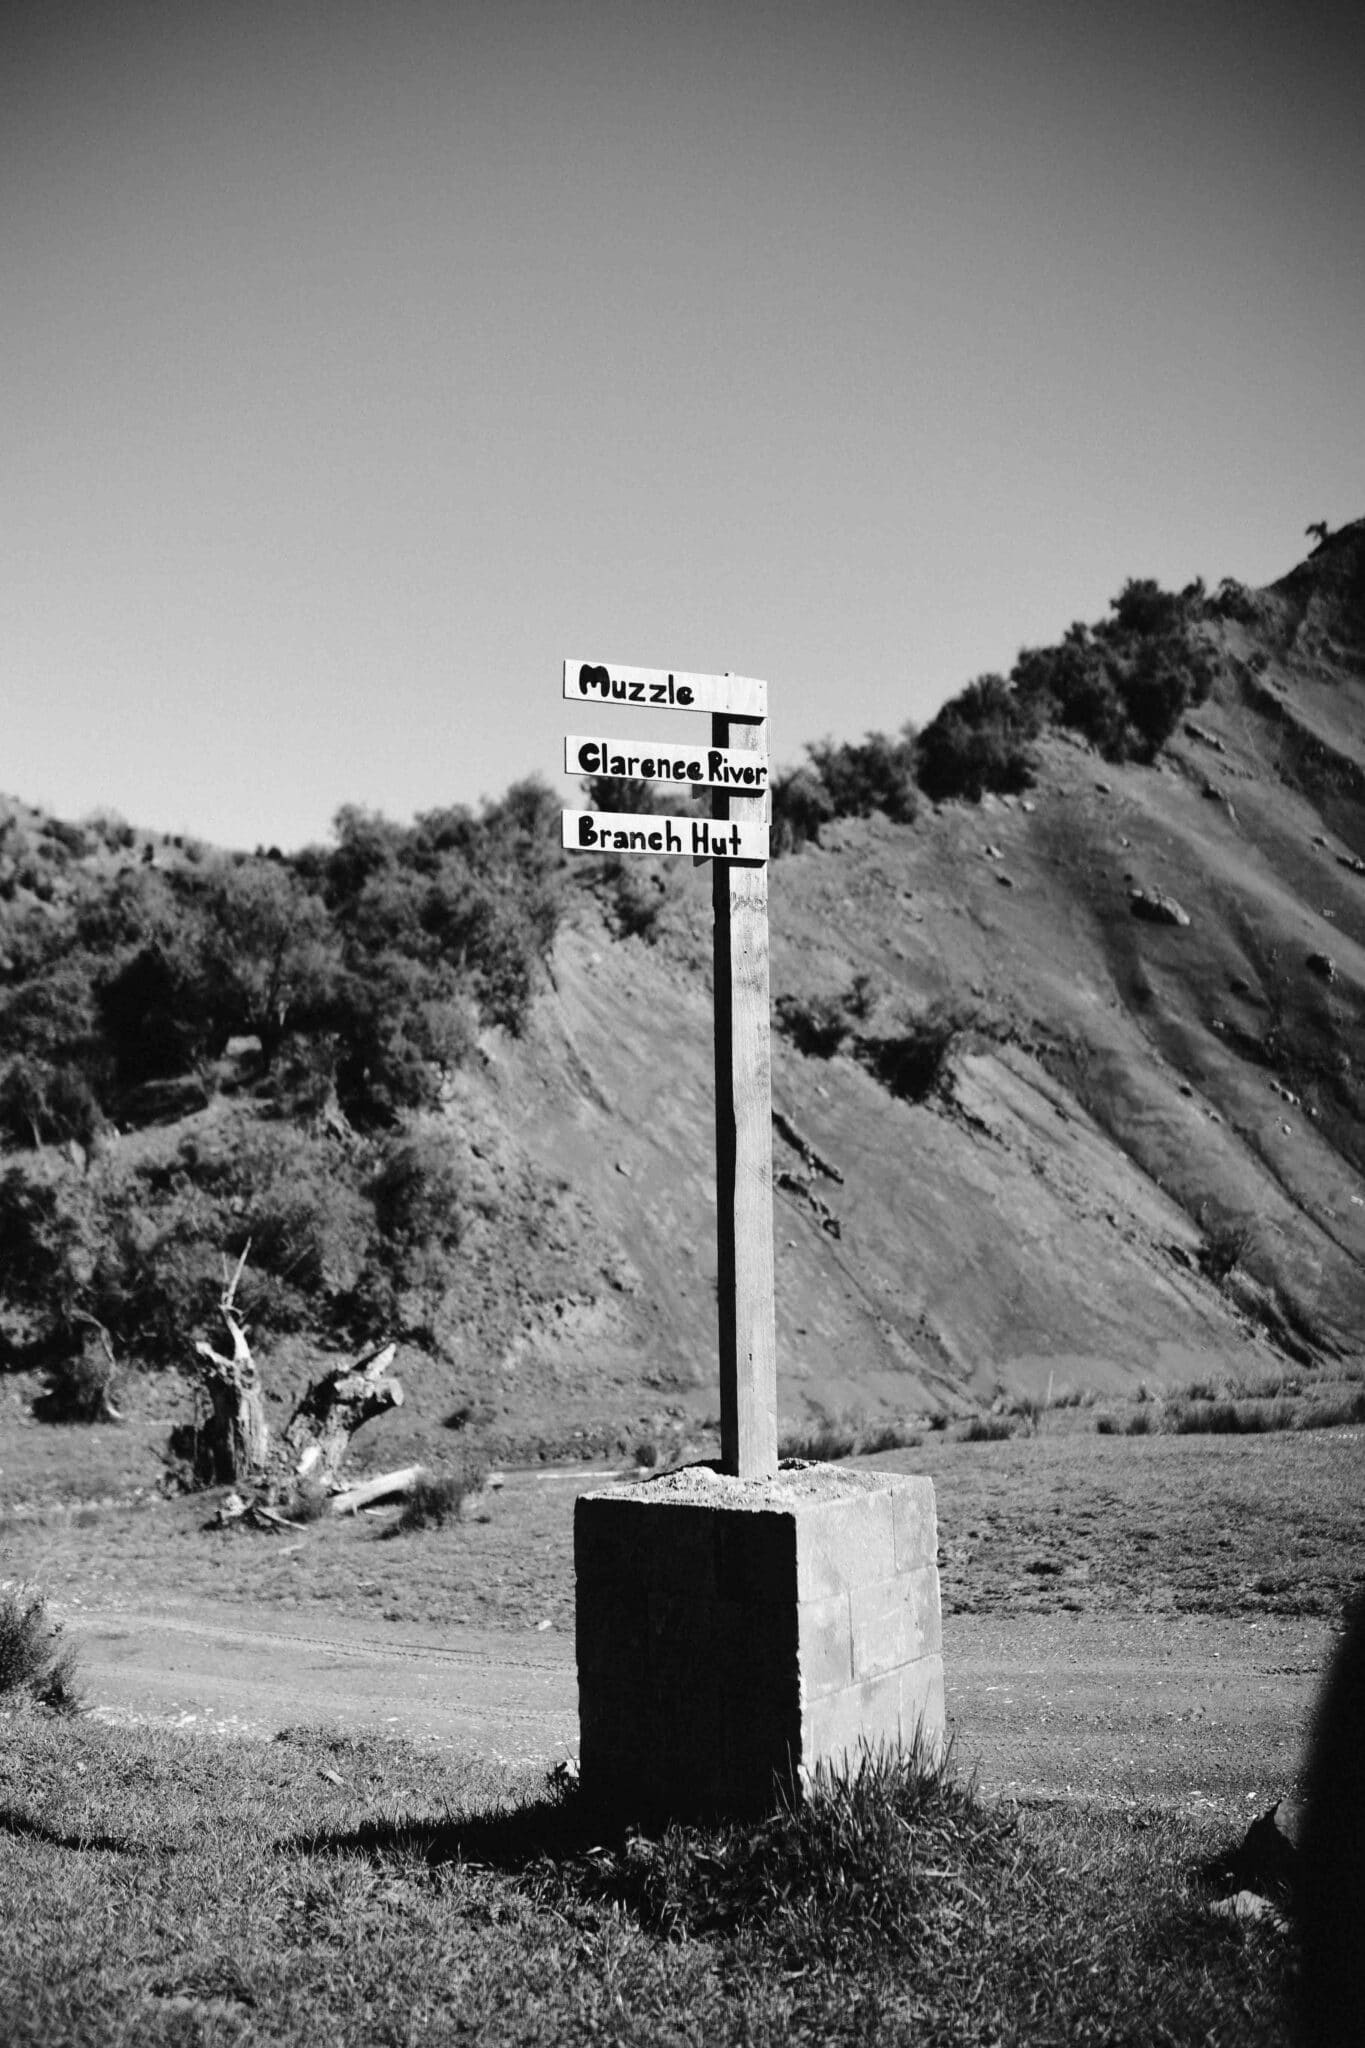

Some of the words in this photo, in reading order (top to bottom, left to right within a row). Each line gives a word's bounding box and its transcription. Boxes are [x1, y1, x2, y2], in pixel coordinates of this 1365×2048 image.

[579, 664, 695, 706] Muzzle
[578, 742, 704, 781] Clarence
[708, 750, 768, 785] River
[578, 815, 682, 852] Branch
[692, 822, 742, 855] Hut
